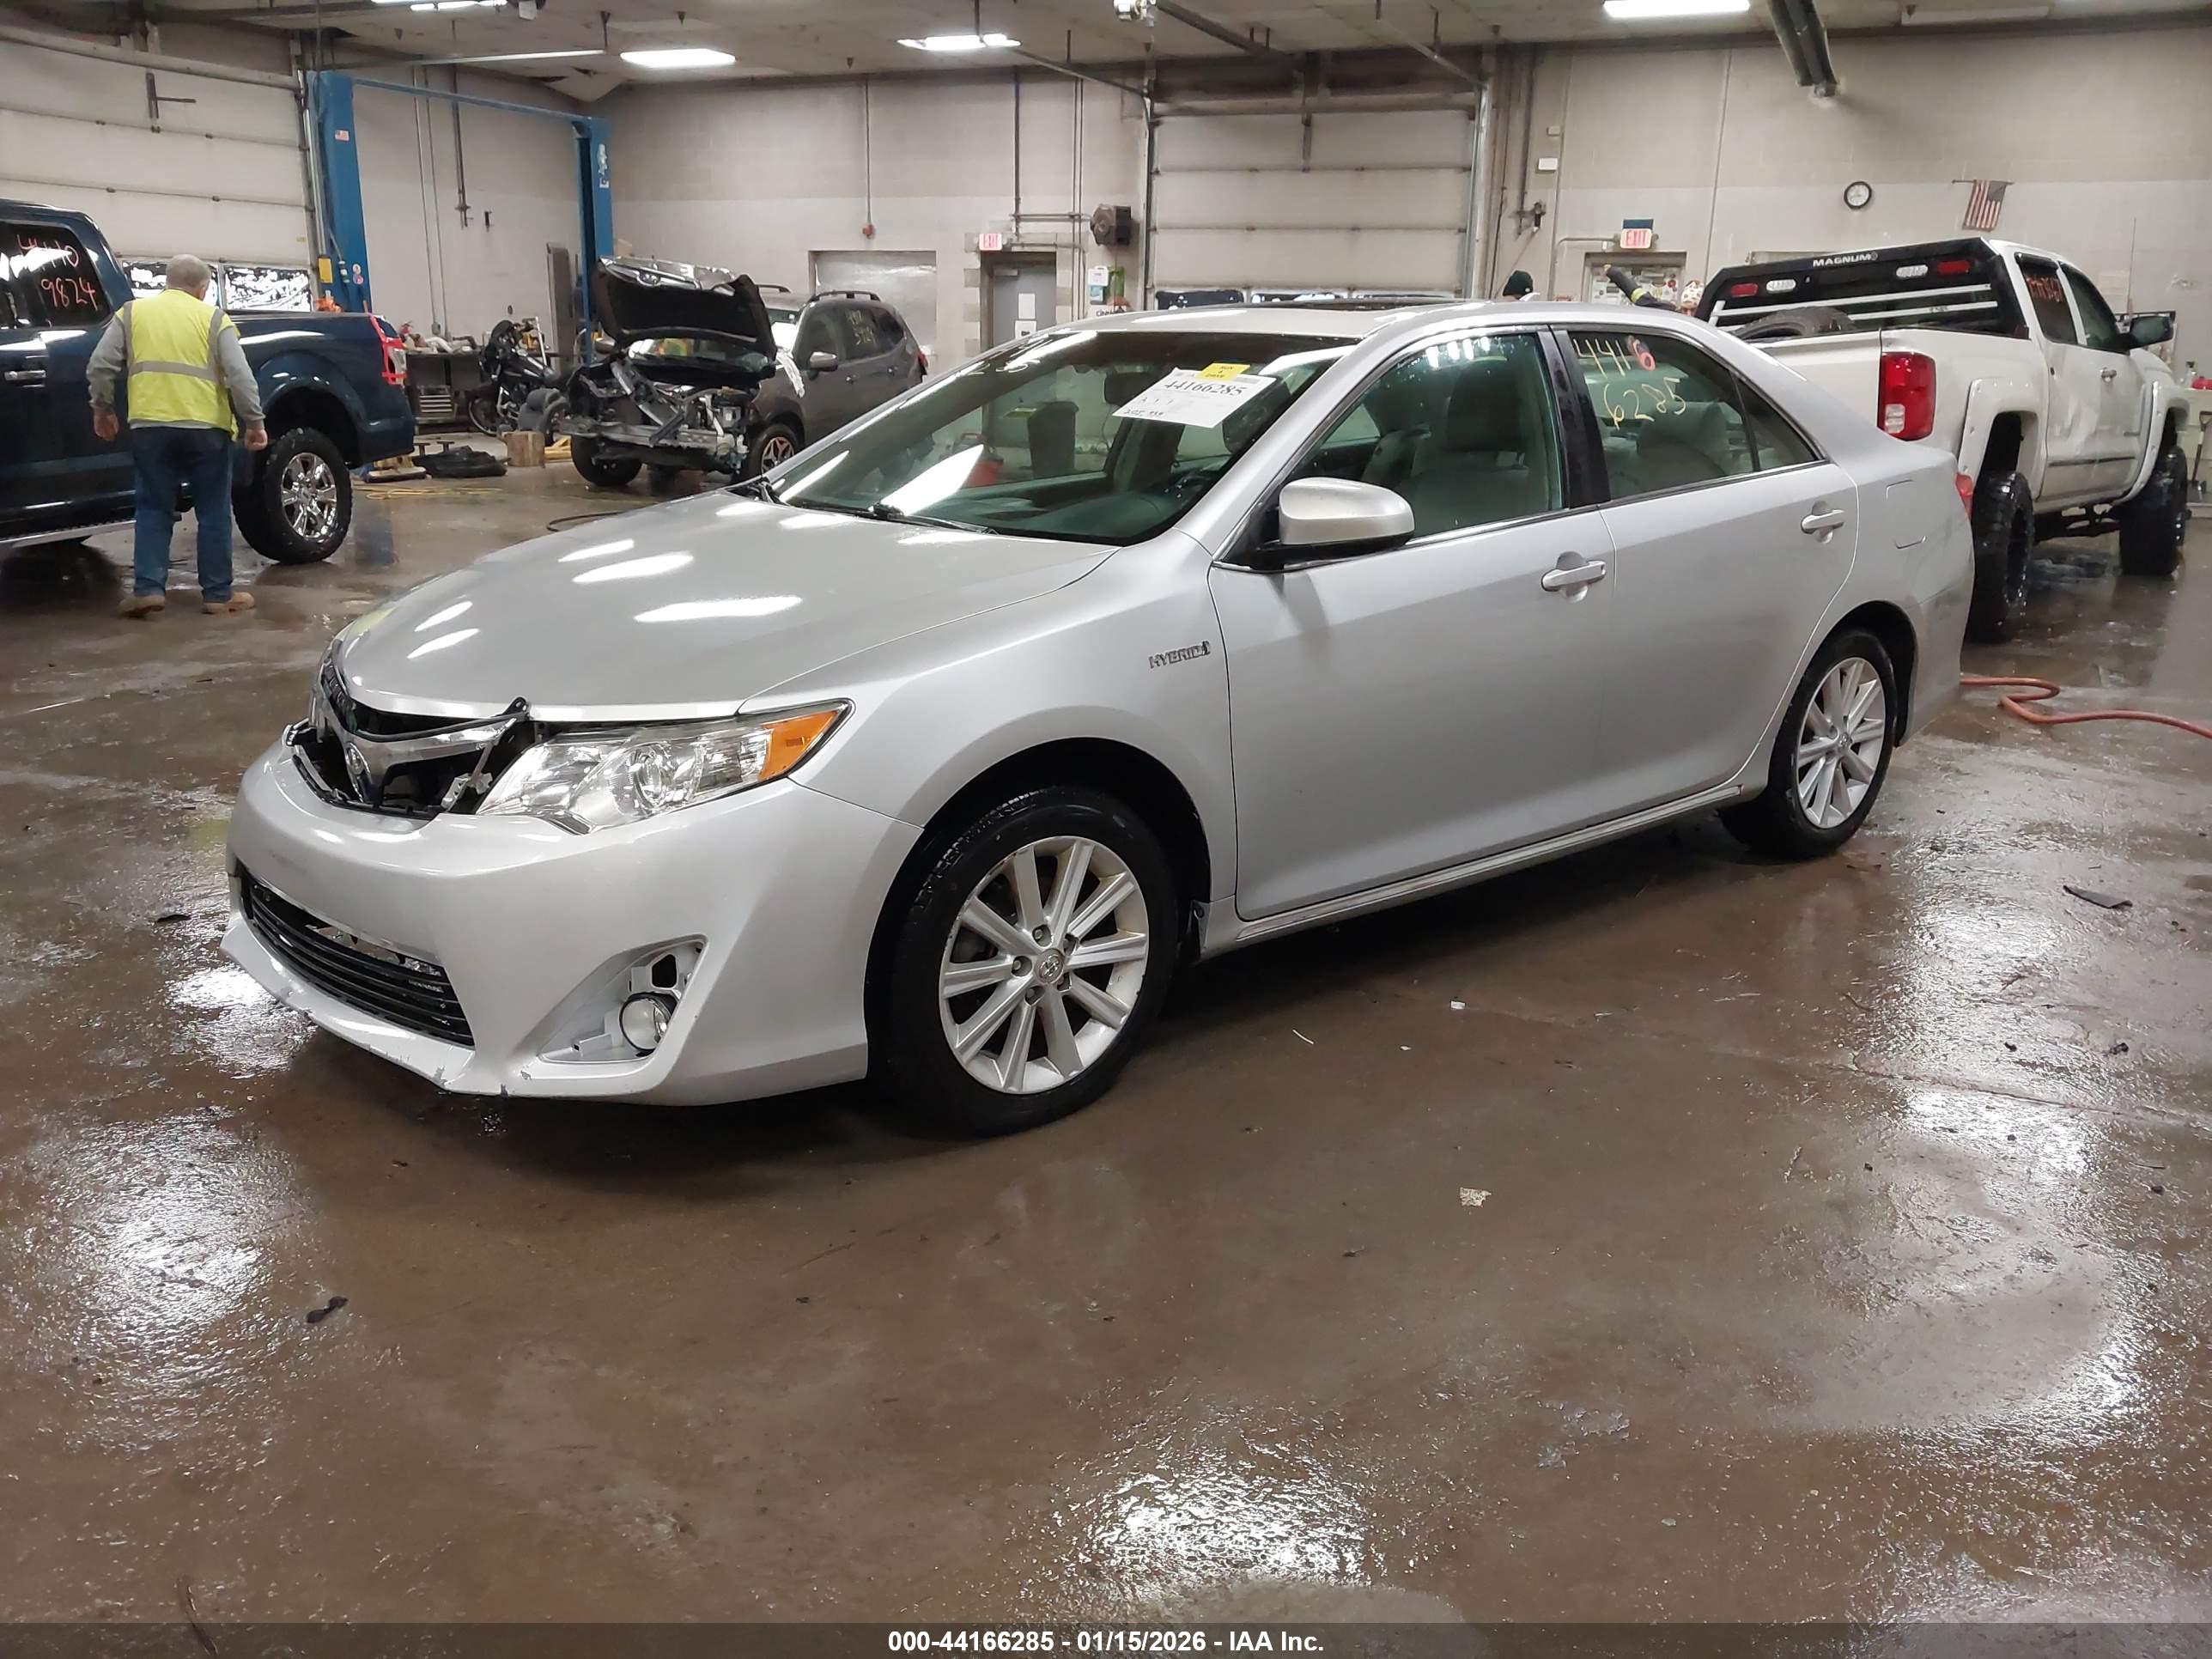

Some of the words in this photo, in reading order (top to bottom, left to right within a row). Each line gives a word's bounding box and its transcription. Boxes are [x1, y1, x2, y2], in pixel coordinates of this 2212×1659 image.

[983, 234, 999, 248] EXIT
[1626, 230, 1648, 246] EXIT
[1813, 253, 1872, 267] MAGNUM
[40, 276, 99, 311] 9824
[1164, 380, 1247, 396] 44166285
[1603, 377, 1686, 430] 6285
[1148, 644, 1206, 669] HYBRID
